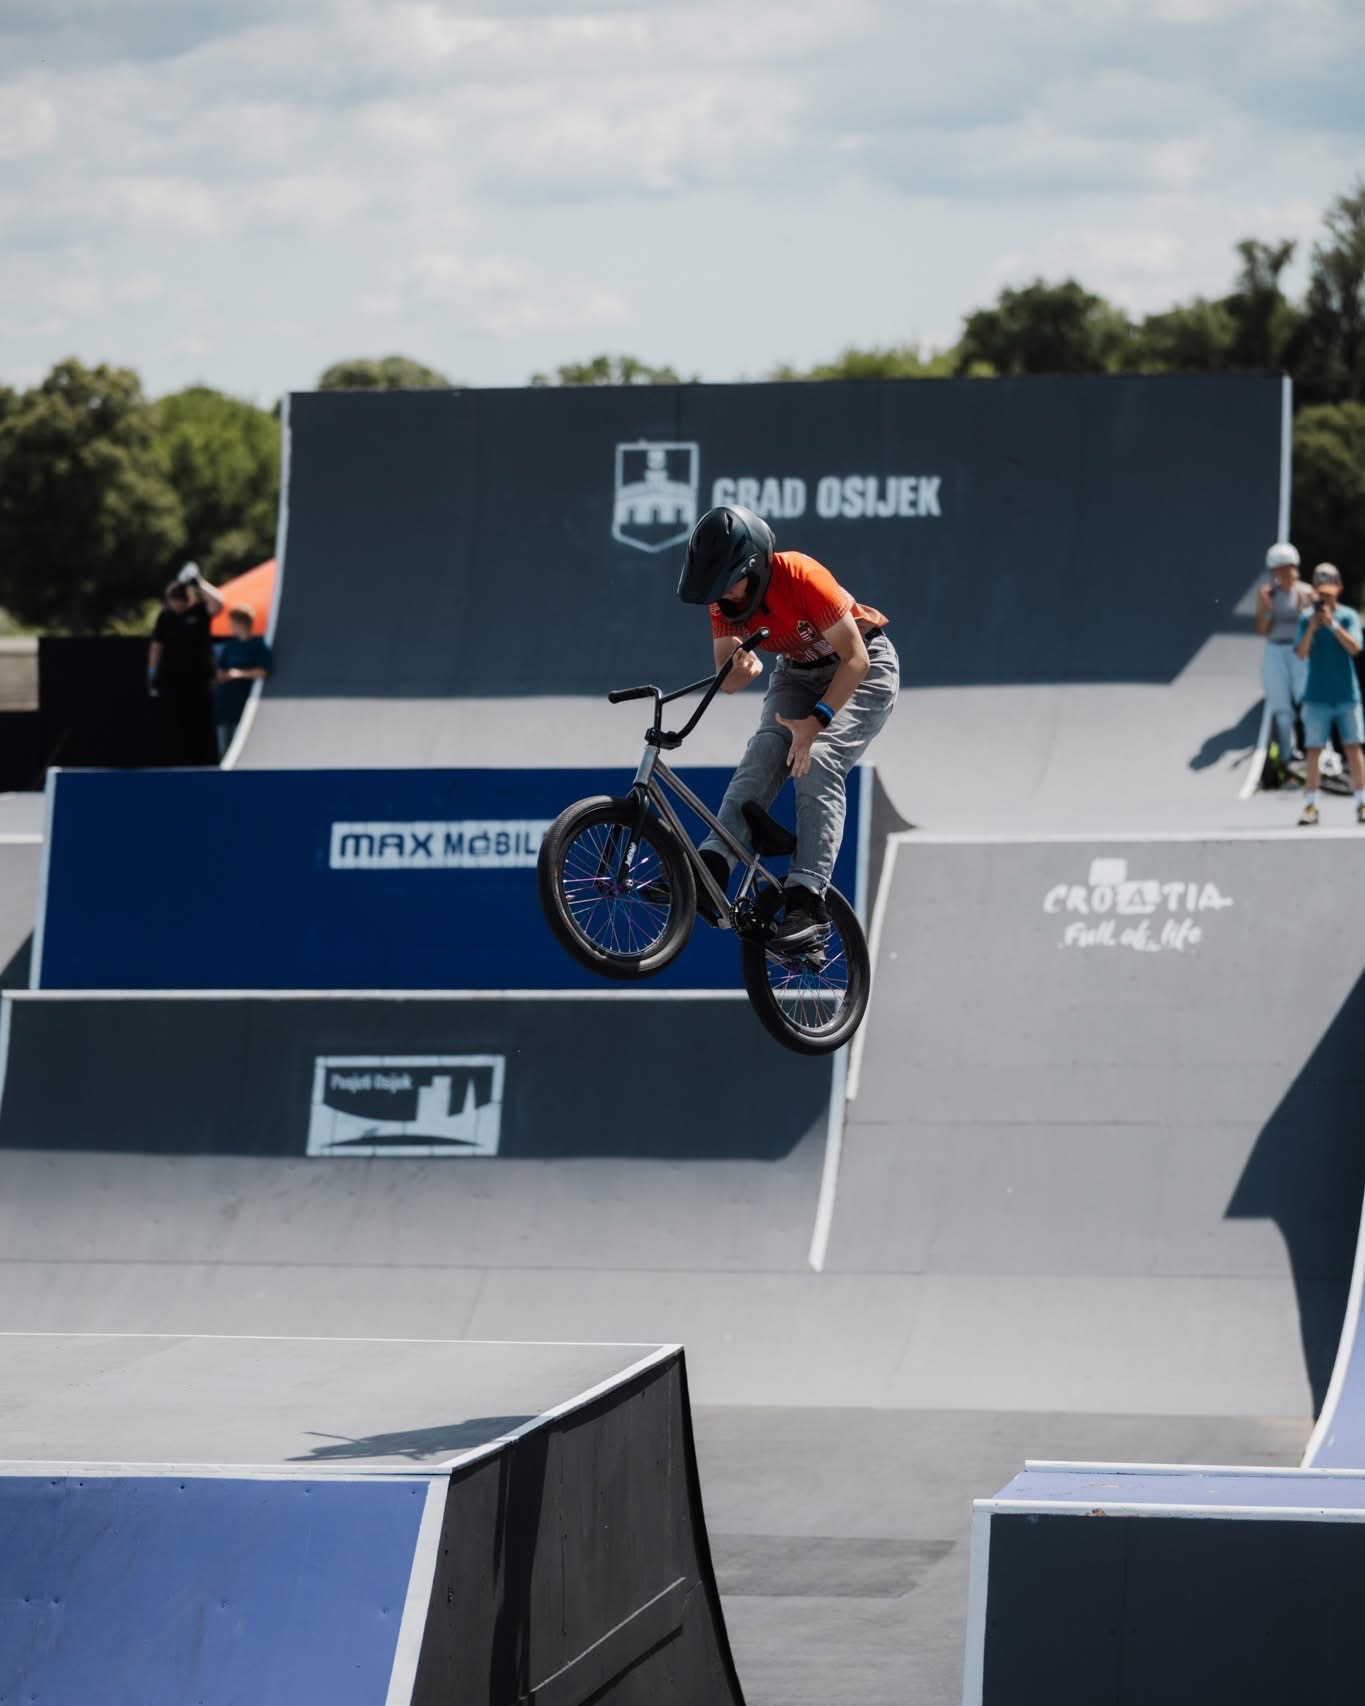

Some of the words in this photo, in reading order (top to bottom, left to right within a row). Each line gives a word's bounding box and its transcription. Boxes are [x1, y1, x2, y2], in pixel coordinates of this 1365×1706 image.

[711, 476, 807, 519] GRAD
[815, 475, 943, 518] OSIJEK
[339, 832, 433, 858] MAX
[1043, 879, 1234, 914] CROATIA
